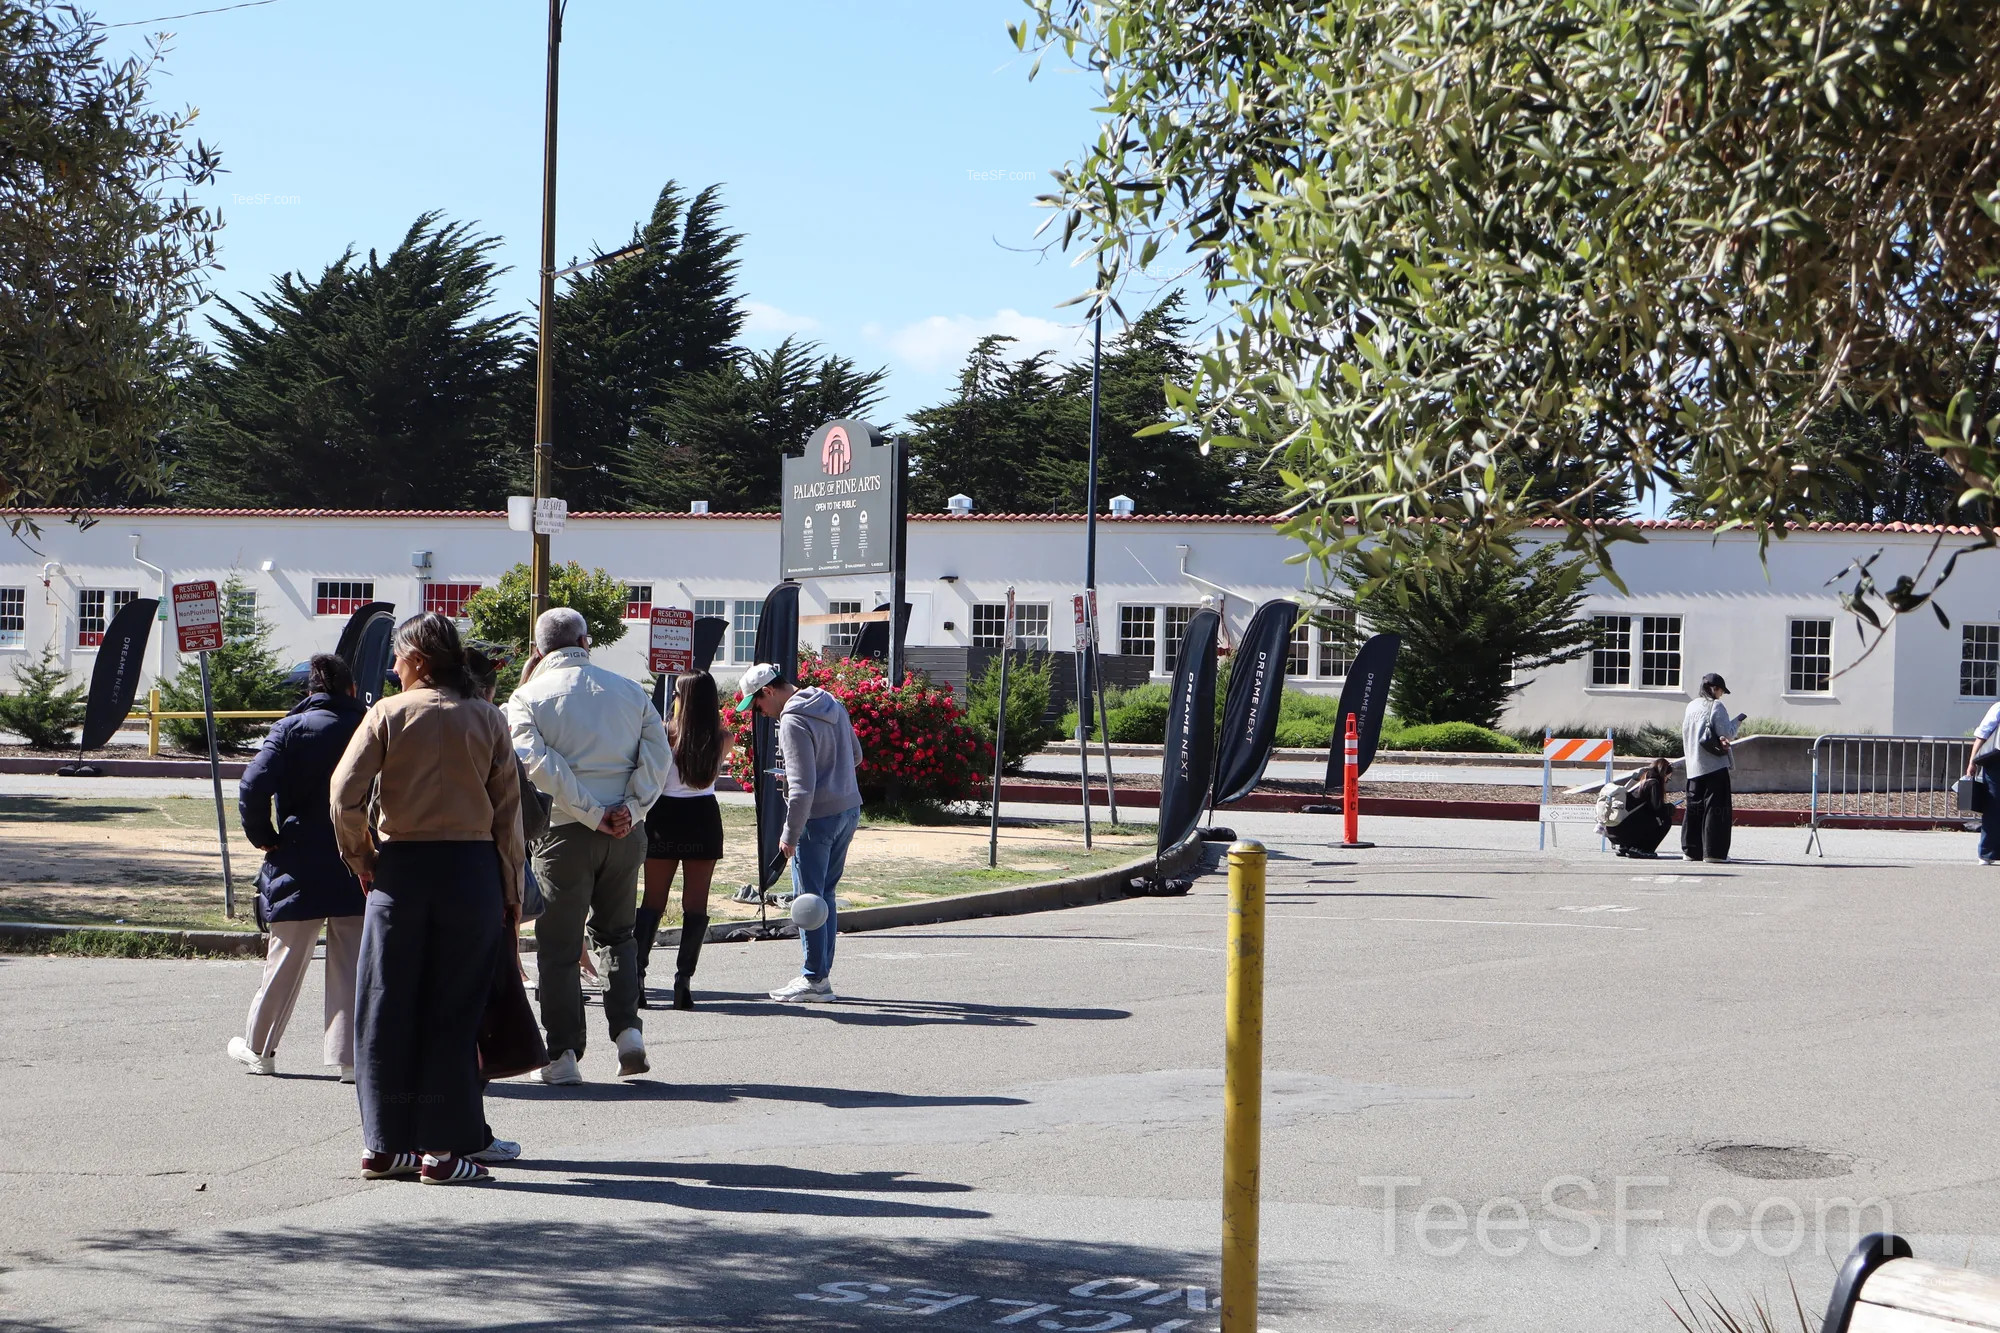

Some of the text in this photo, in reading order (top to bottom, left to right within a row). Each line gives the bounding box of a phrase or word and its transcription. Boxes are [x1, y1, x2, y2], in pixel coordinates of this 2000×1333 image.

[793, 475, 881, 499] PALACE OF FINE ARTS
[815, 499, 857, 512] OPEN TO THE PUBLIC
[179, 583, 209, 593] RESERVED
[175, 592, 201, 601] PARKING
[179, 608, 216, 617] NonPlusUltra
[657, 610, 687, 618] RESERVED
[653, 634, 690, 642] NonPlusUltra
[111, 636, 131, 705] DREAME NEXT
[1246, 651, 1267, 745] DREAME NEXT
[1360, 672, 1375, 712] DREAME
[1179, 672, 1194, 782] DREAME NEXT
